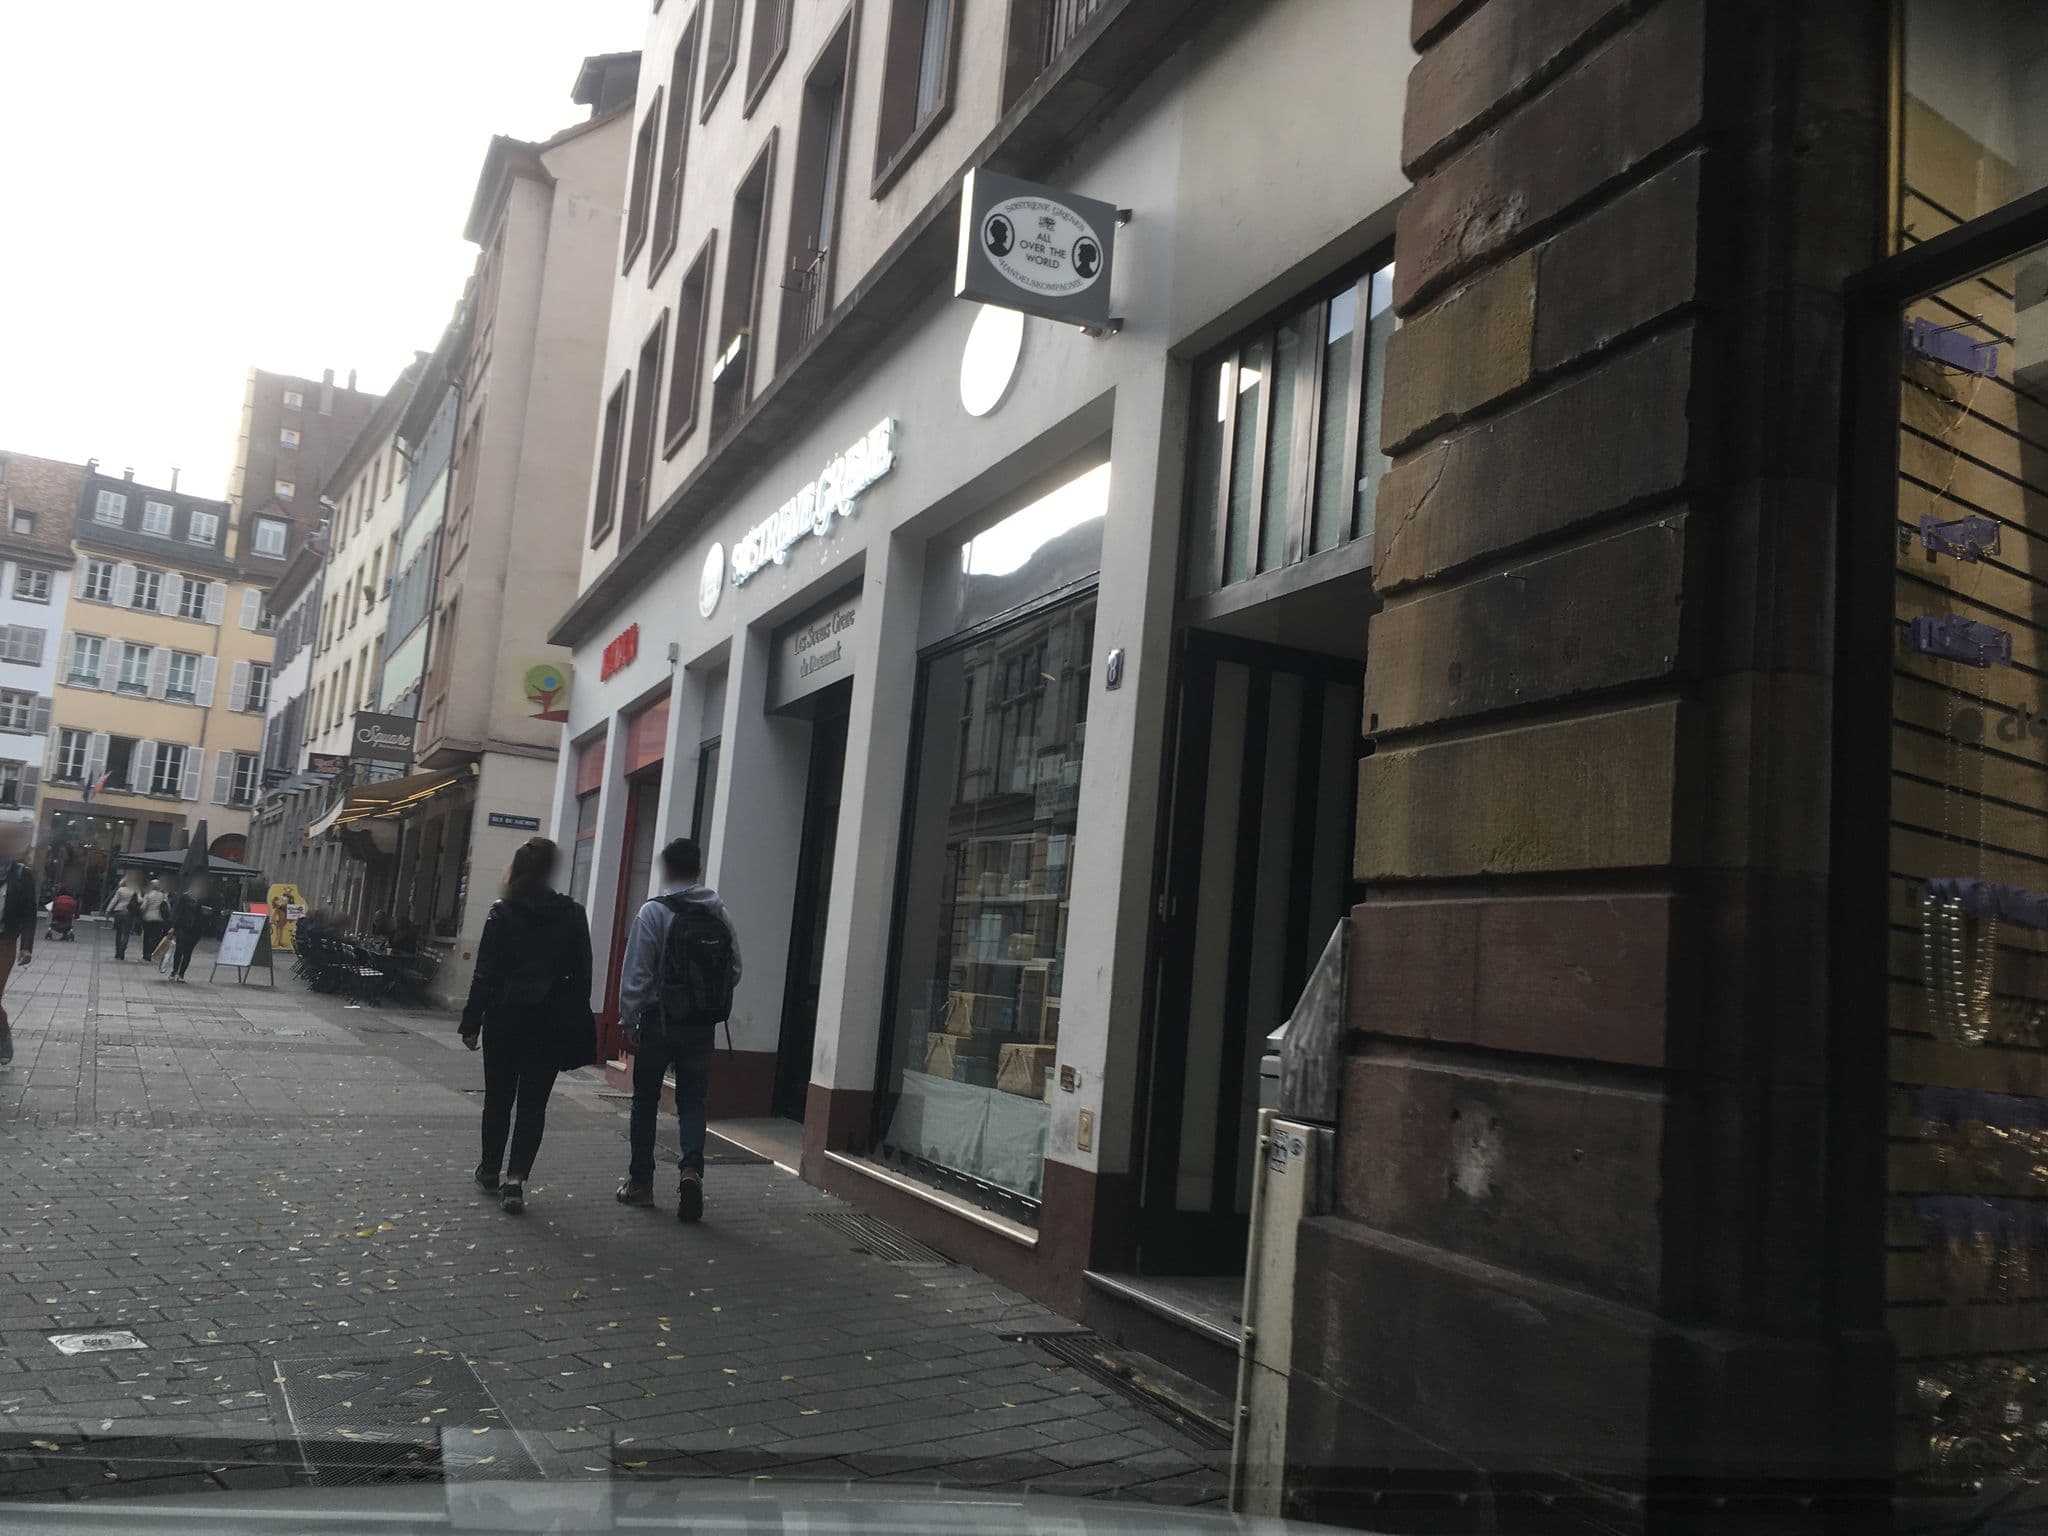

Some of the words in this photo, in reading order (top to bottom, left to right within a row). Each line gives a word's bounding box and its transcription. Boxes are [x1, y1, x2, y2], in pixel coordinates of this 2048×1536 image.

[1037, 233, 1053, 244] ALL
[1019, 240, 1046, 253] OVER
[1050, 247, 1067, 259] THE
[1026, 253, 1060, 269] WORLD
[357, 725, 411, 748] Square
